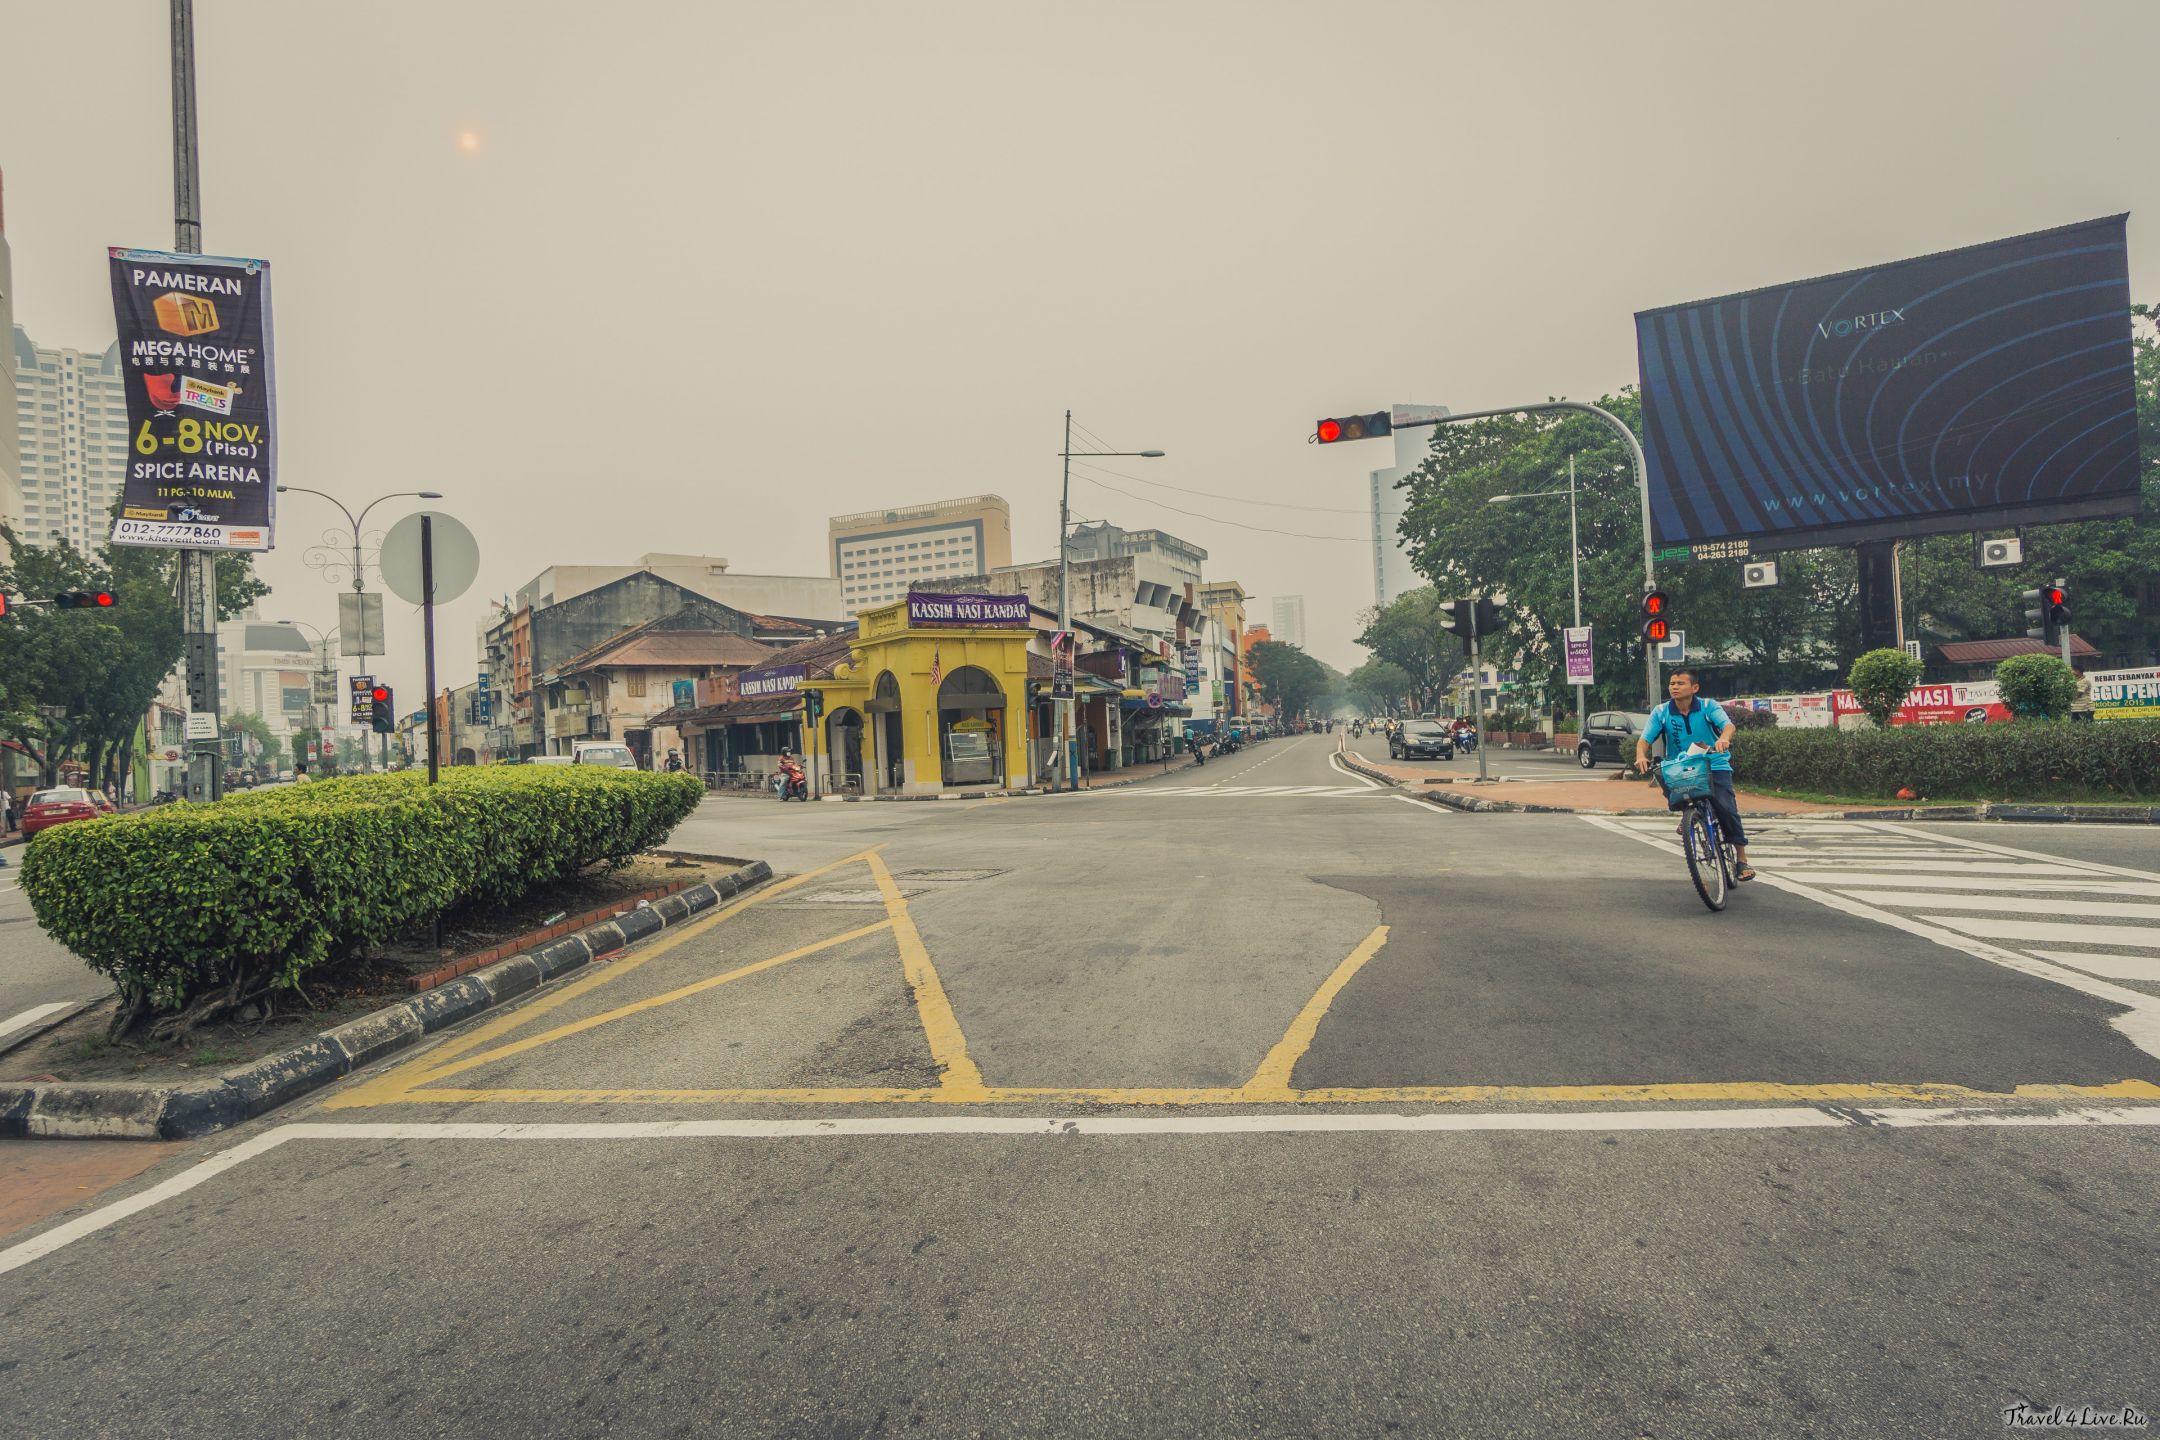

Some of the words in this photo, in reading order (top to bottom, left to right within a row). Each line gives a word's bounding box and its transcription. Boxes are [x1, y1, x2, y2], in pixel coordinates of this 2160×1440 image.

[133, 269, 242, 296] PAMERAN
[1818, 308, 1905, 340] VORTEX
[185, 390, 226, 409] TREATS
[136, 418, 203, 455] 6-8
[204, 420, 264, 444] NOV.
[133, 462, 184, 479] SPICE
[188, 462, 261, 483] ARENA
[192, 487, 205, 497] 10
[1692, 542, 1726, 553] 019-574
[1728, 540, 1748, 549] 2180
[1698, 551, 1726, 560] 04-263
[1728, 549, 1748, 557] 2180
[911, 602, 953, 619] KASSIM
[956, 604, 981, 619] NASI
[984, 603, 1028, 619] KANDAR
[2118, 673, 2155, 681] SEBANYAK
[762, 678, 777, 693] NASI
[2091, 686, 2123, 701] GGU
[2094, 700, 2120, 708] ktober
